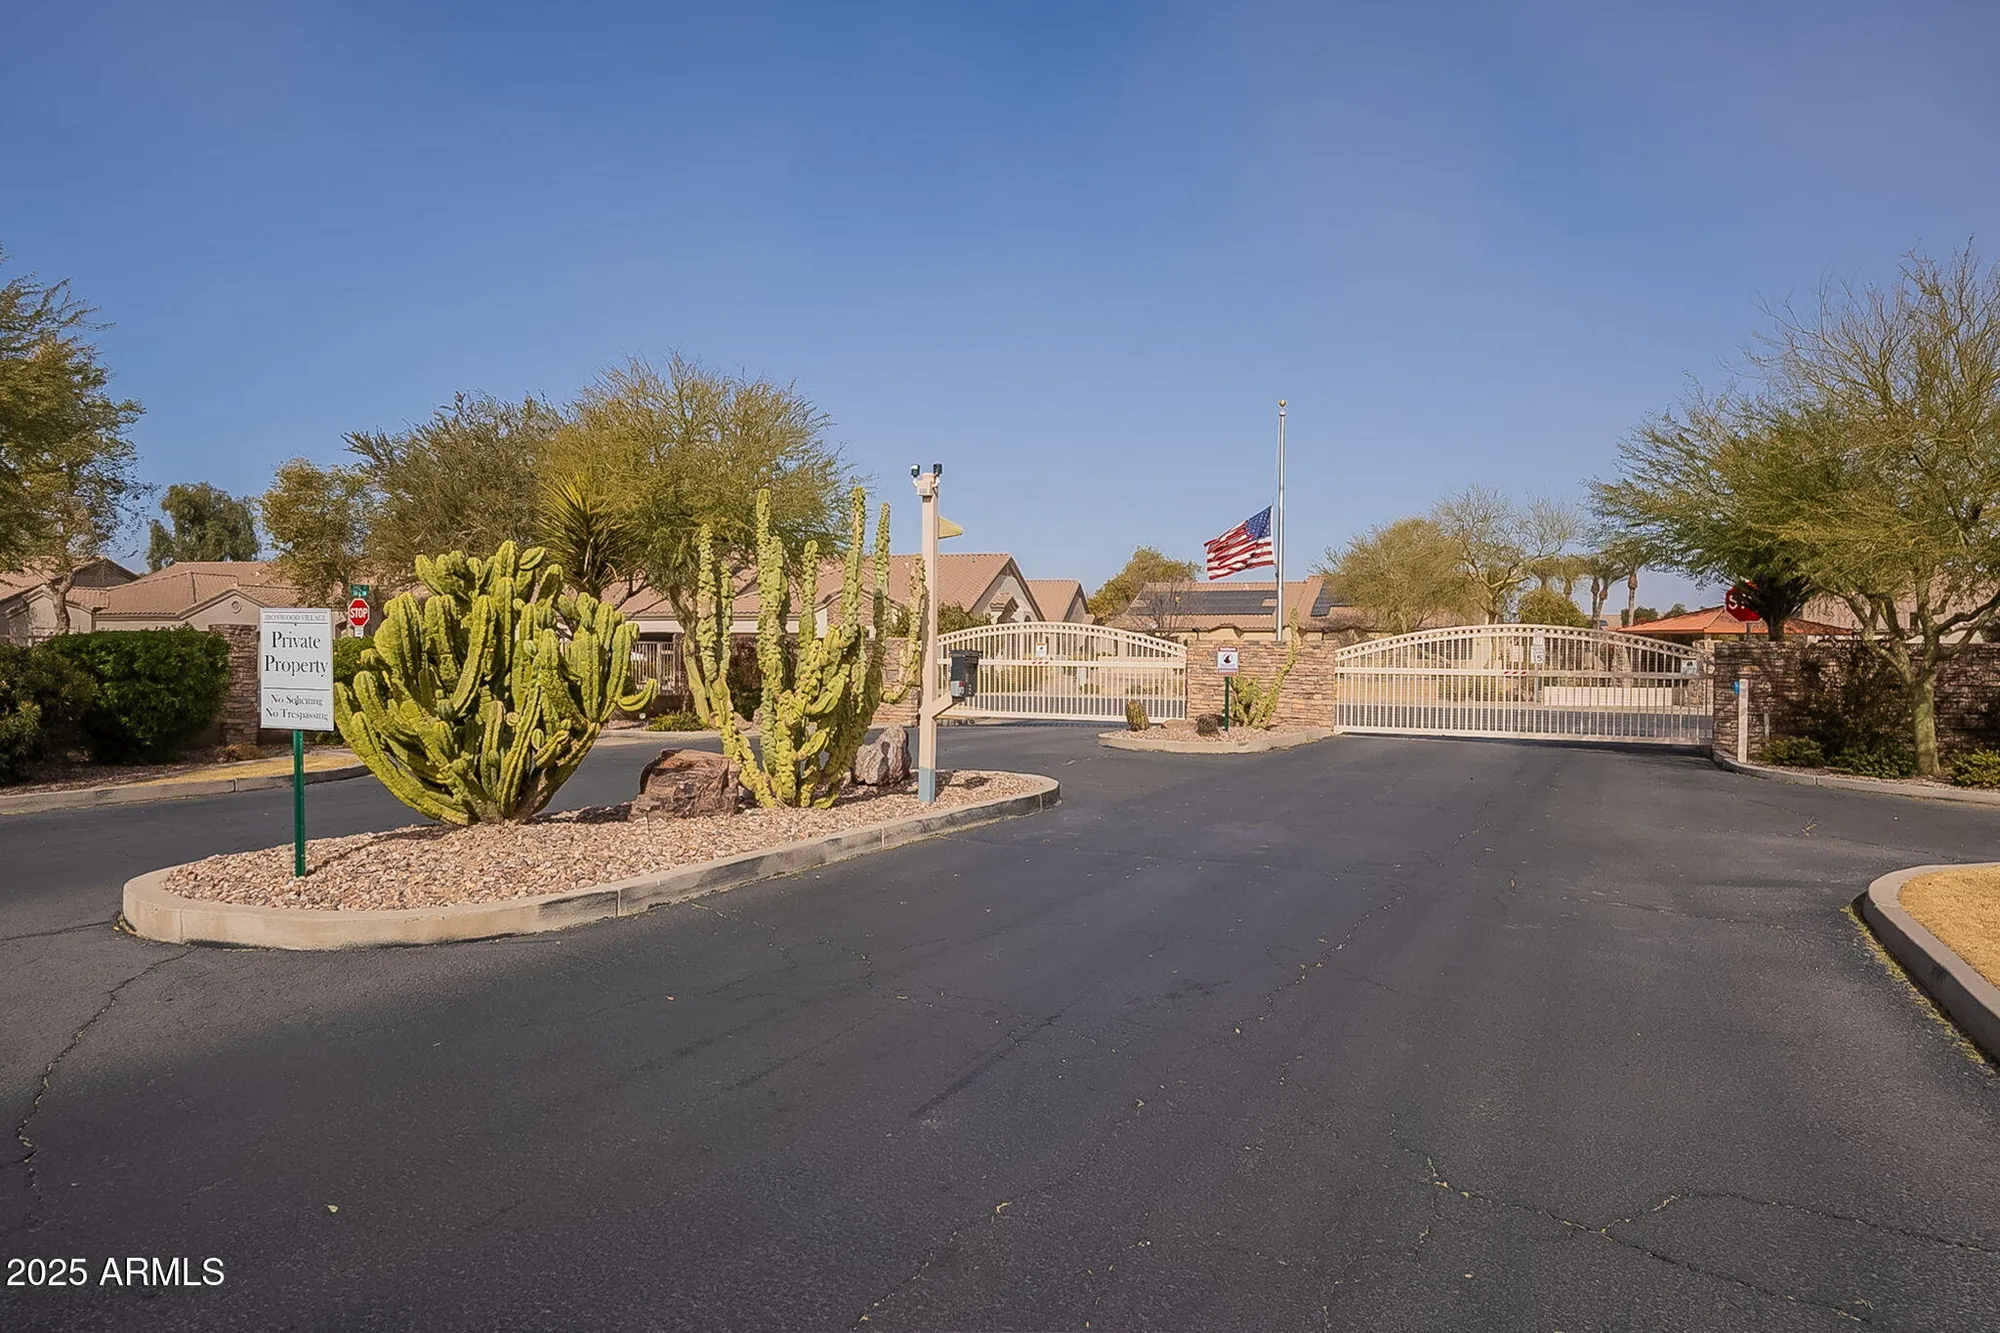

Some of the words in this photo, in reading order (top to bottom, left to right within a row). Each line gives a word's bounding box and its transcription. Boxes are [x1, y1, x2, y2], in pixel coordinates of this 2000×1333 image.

[302, 614, 327, 622] VILLAGE
[350, 607, 368, 619] STOP
[272, 631, 321, 649] Private
[264, 655, 328, 677] Property
[271, 694, 284, 703] No
[286, 694, 323, 706] Soliciting
[265, 708, 278, 717] No
[281, 708, 328, 720] Trespassing
